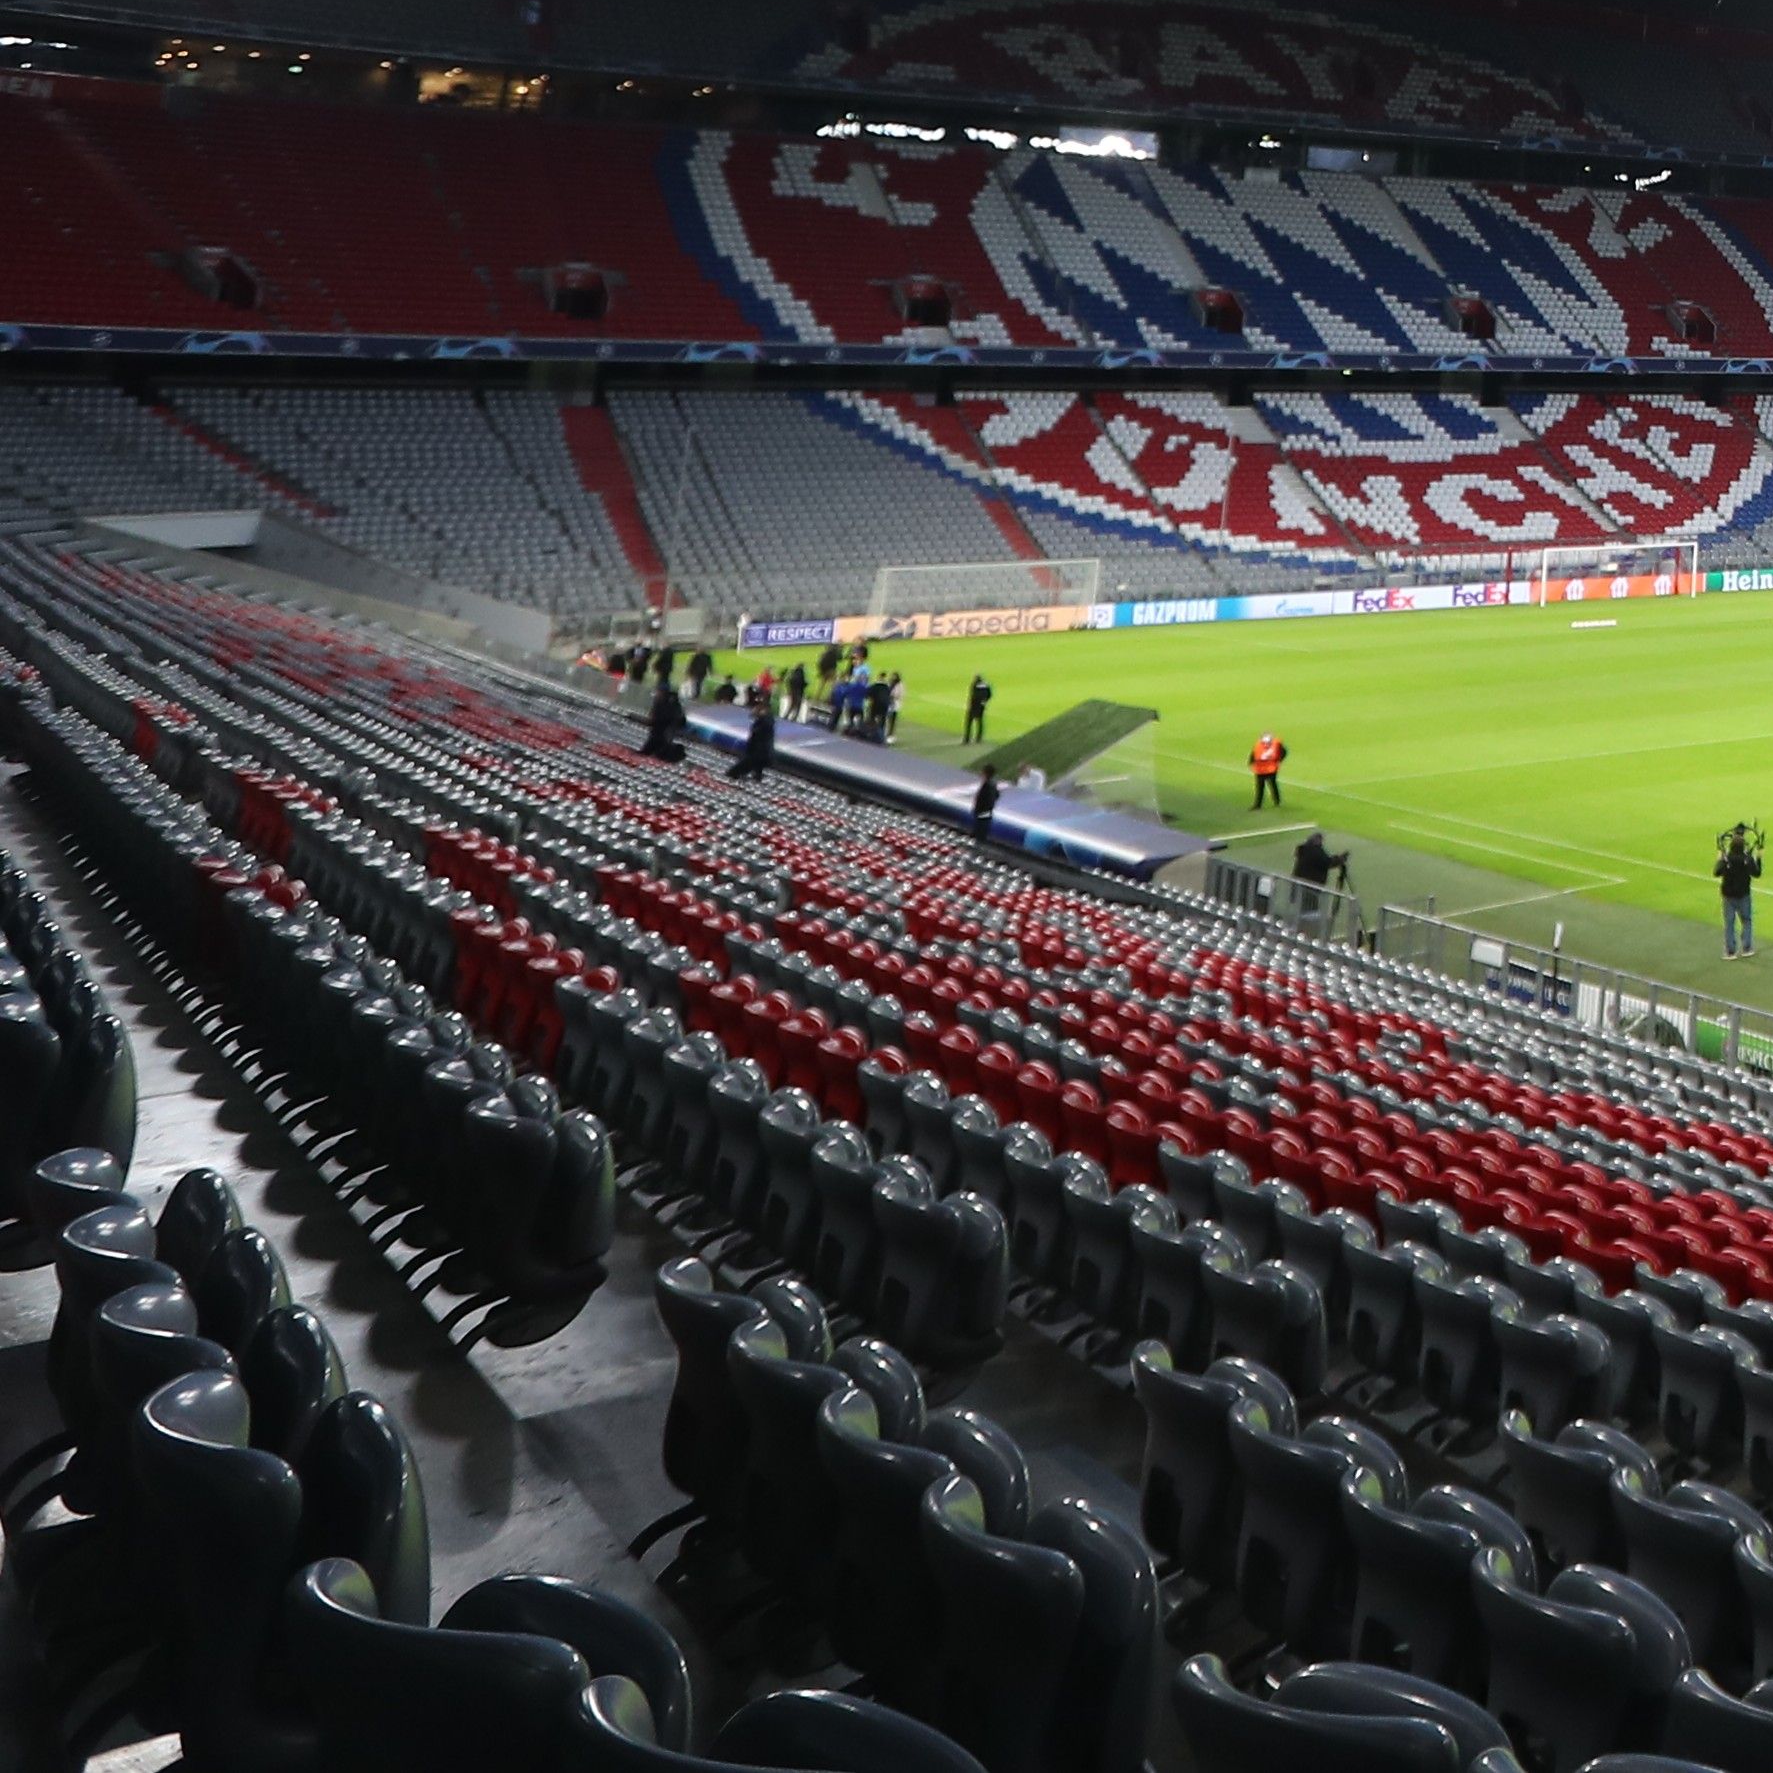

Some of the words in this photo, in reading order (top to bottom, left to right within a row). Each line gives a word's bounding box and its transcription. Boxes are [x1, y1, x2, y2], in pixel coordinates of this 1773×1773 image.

[1352, 588, 1415, 612] FedEx
[929, 609, 1050, 637] Expedia
[1131, 600, 1217, 625] GAZPROM
[767, 624, 832, 643] RESPECT
